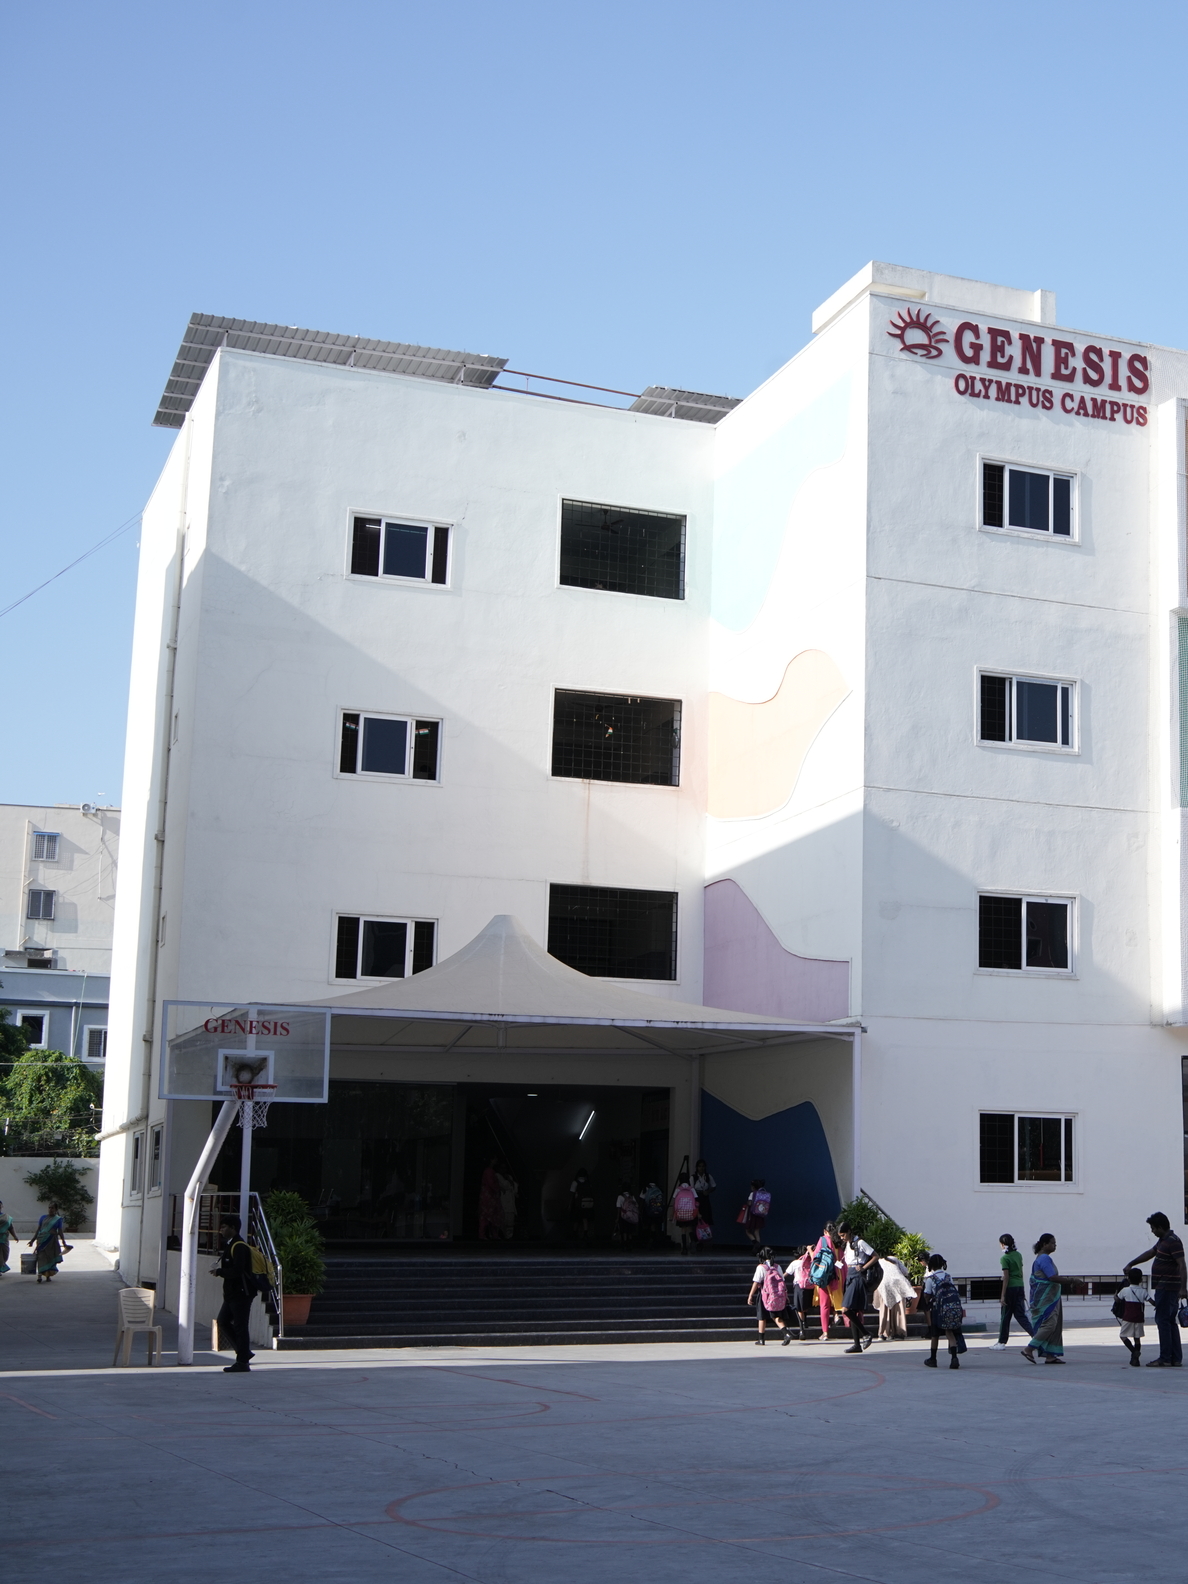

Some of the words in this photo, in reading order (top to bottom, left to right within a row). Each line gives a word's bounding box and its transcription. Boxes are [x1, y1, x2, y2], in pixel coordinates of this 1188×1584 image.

[954, 321, 1149, 395] GENESIS
[954, 373, 1054, 411] OLYMPUS
[1060, 391, 1149, 427] CAMPUS
[203, 1018, 290, 1037] GENESIS
